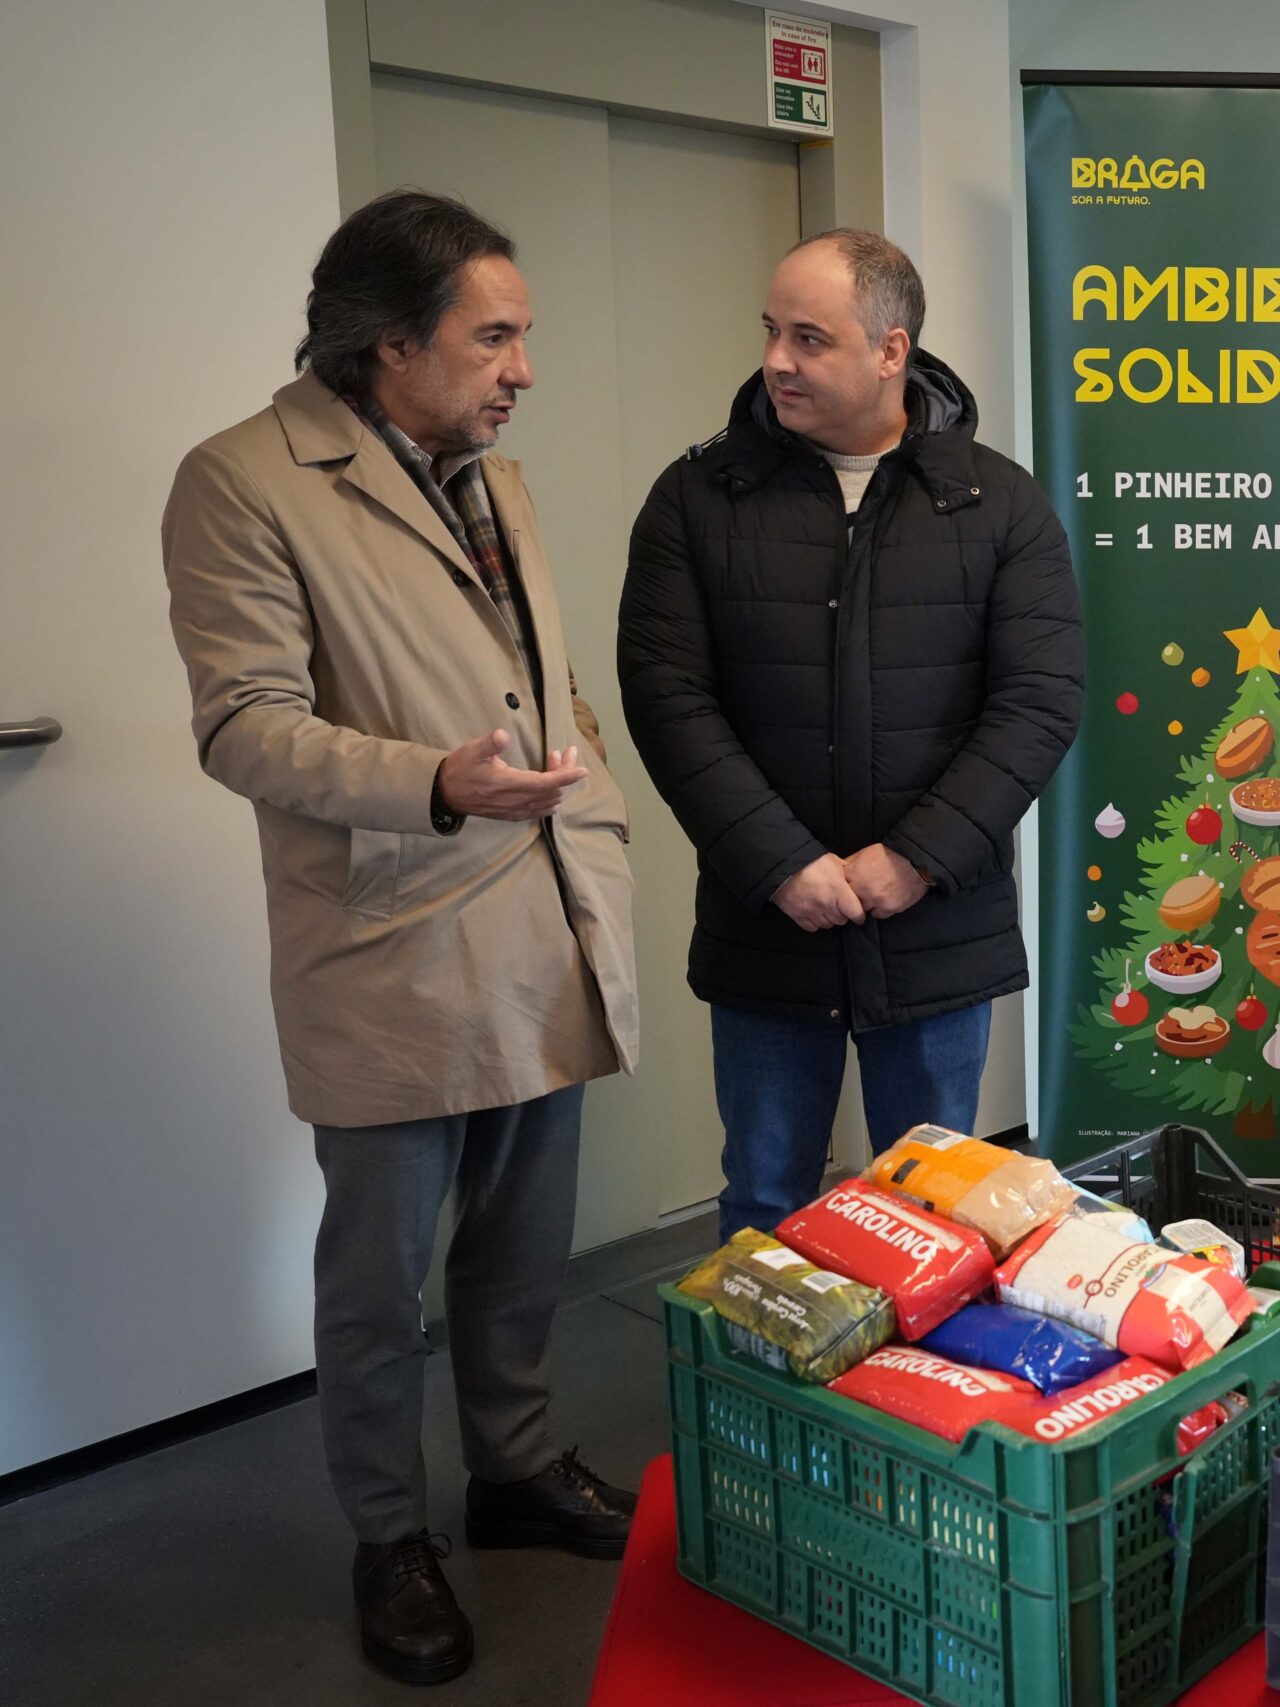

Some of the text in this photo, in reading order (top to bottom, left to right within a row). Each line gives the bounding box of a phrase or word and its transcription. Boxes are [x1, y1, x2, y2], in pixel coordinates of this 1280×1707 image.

[1072, 155, 1205, 192] BRAGA
[1077, 472, 1093, 497] 1
[1115, 473, 1272, 498] PINHEIRO
[1137, 524, 1153, 548] 1
[1175, 524, 1231, 549] BEM
[826, 1191, 939, 1262] CAROLINO
[864, 1352, 988, 1397] CAROLINO
[1036, 1372, 1165, 1440] CAROLINO
